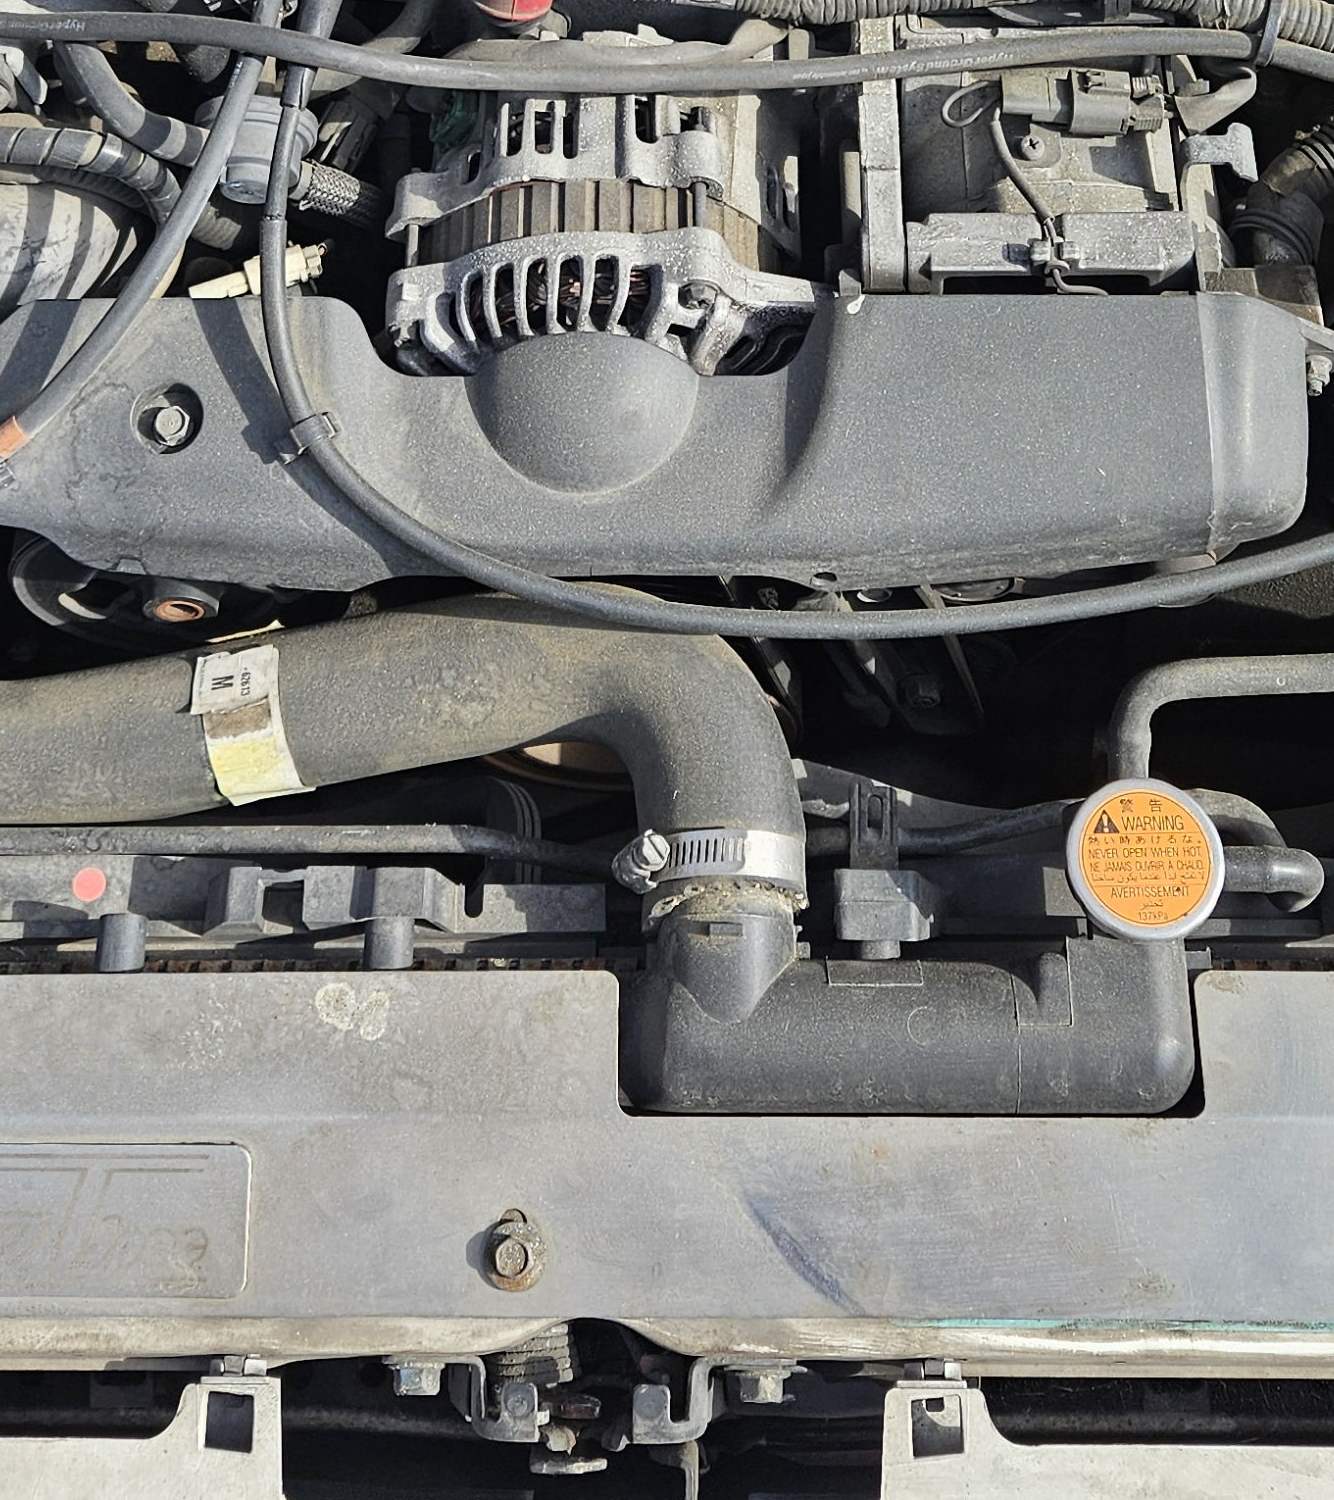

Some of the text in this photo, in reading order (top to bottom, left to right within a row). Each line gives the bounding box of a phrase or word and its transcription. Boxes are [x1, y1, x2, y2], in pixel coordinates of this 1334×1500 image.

[211, 675, 235, 691] M
[1121, 815, 1184, 831] WARNING
[1088, 848, 1118, 859] NEVER
[1122, 847, 1148, 858] OPEN
[1150, 846, 1179, 858] WHEN
[1089, 861, 1100, 872] NE
[1103, 861, 1133, 872] JAMAIS
[1135, 860, 1164, 871] OUVRIR
[1110, 885, 1190, 899] AVERTISSEMENT
[1137, 911, 1169, 921] 137kPa
